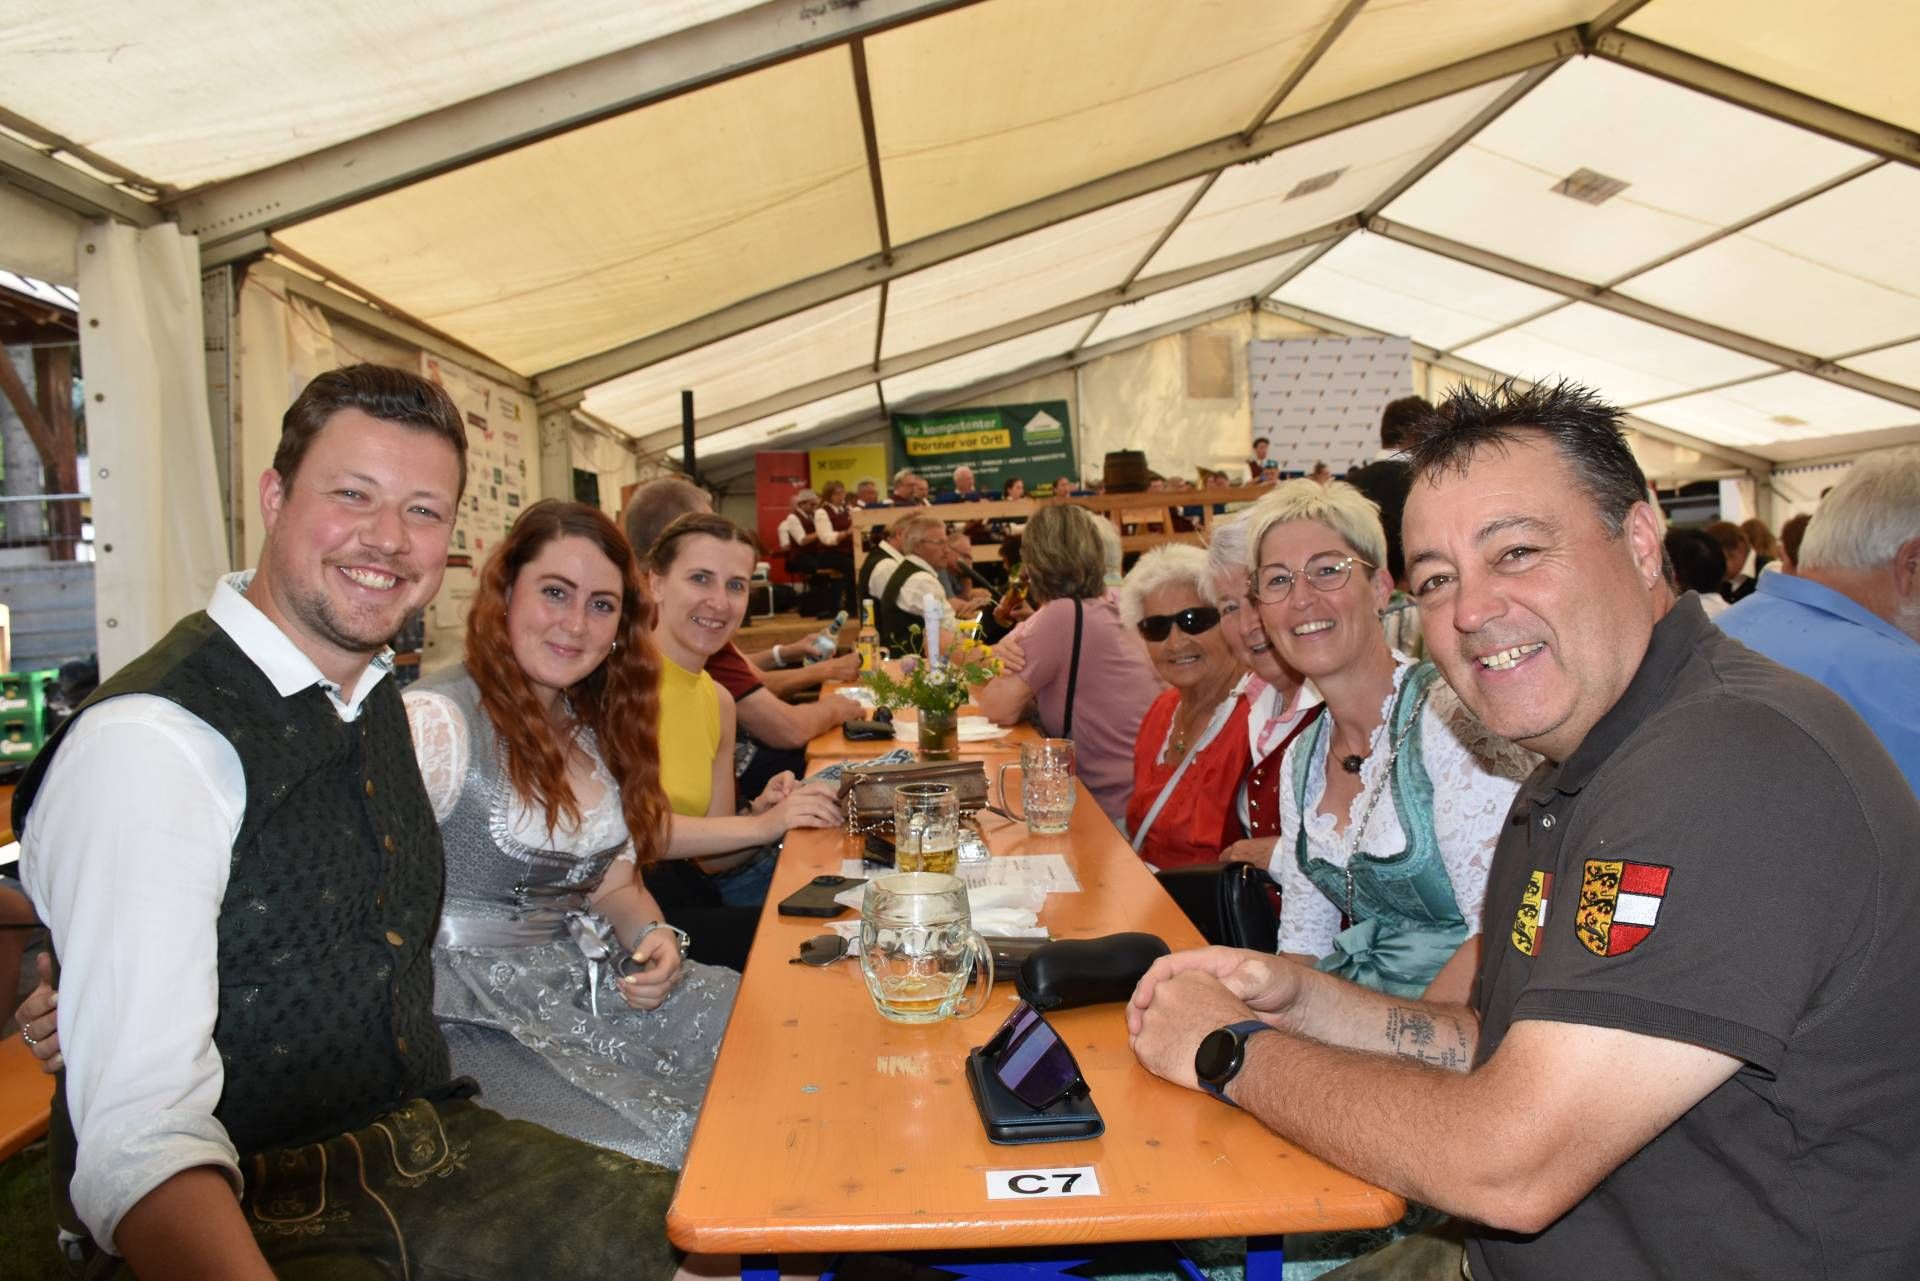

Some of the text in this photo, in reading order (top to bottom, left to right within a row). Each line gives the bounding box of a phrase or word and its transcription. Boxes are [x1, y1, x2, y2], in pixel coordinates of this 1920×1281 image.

[922, 419, 997, 435] kompetenter
[912, 434, 1004, 451] Partner vor Ort!
[1008, 1173, 1082, 1194] C7
